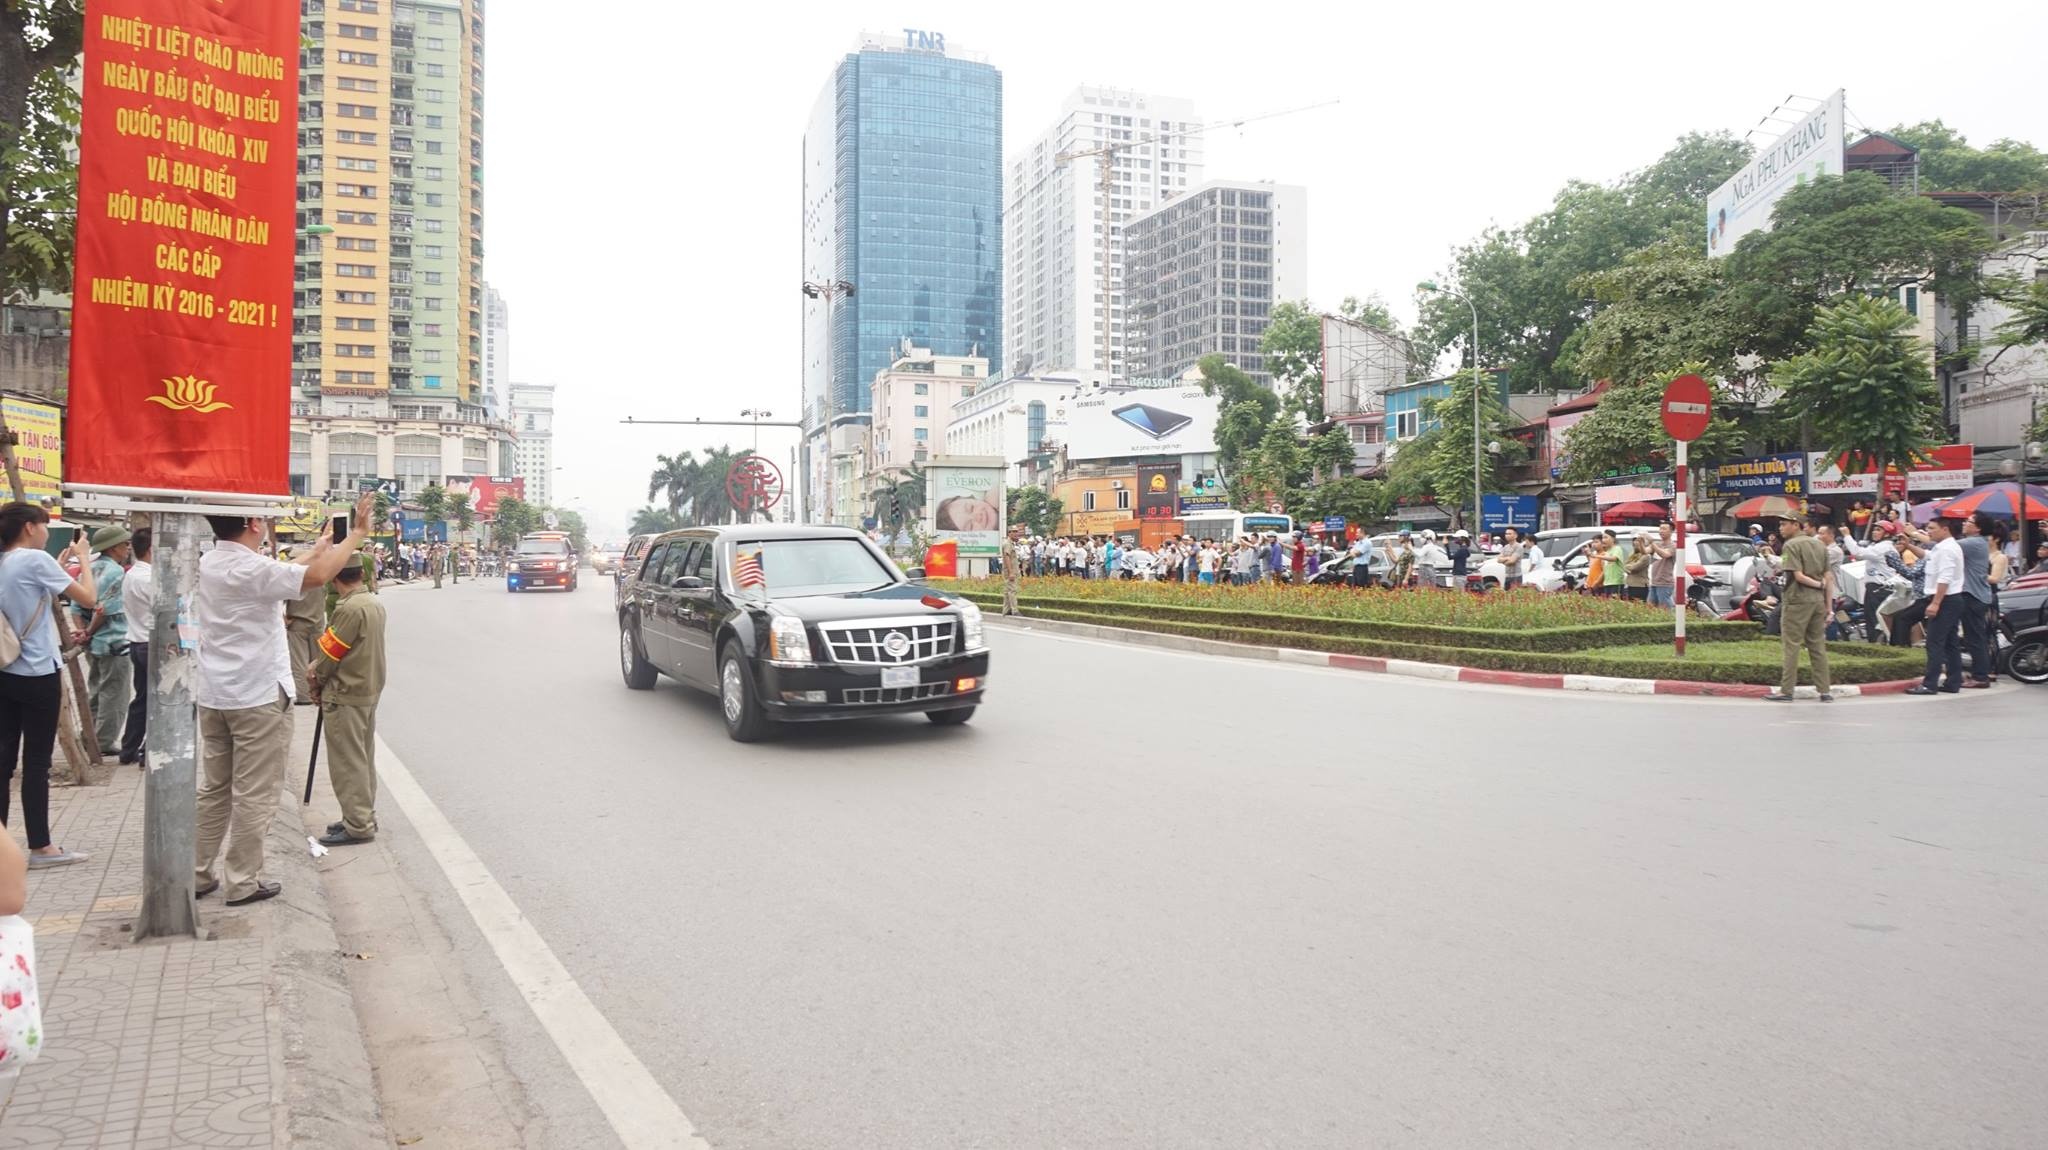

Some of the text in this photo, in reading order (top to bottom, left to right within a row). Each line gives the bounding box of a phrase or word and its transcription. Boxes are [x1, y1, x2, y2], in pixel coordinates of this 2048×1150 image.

[102, 14, 284, 81] NHIỆT LIỆT CHÀO MỪNG
[903, 28, 945, 52] TNR
[103, 60, 280, 124] NGÀY BẦU CỬ ĐẠI BIỂU
[116, 104, 269, 164] QUỐC HỘI KHÓA XIV
[1732, 110, 1827, 206] NGA PHỤ KHANG
[147, 153, 236, 200] VÀ ĐẠI BIỂU
[107, 189, 269, 246] HỘI ĐỒNG NHÂN DÂN
[155, 241, 222, 279] CÁC CẤP
[92, 275, 149, 312] NHIỆM
[153, 281, 176, 312] KỲ
[178, 289, 214, 319] 2016
[228, 298, 265, 326] 2021
[1076, 400, 1105, 409] SAMSUNG
[1784, 479, 1801, 493] 34
